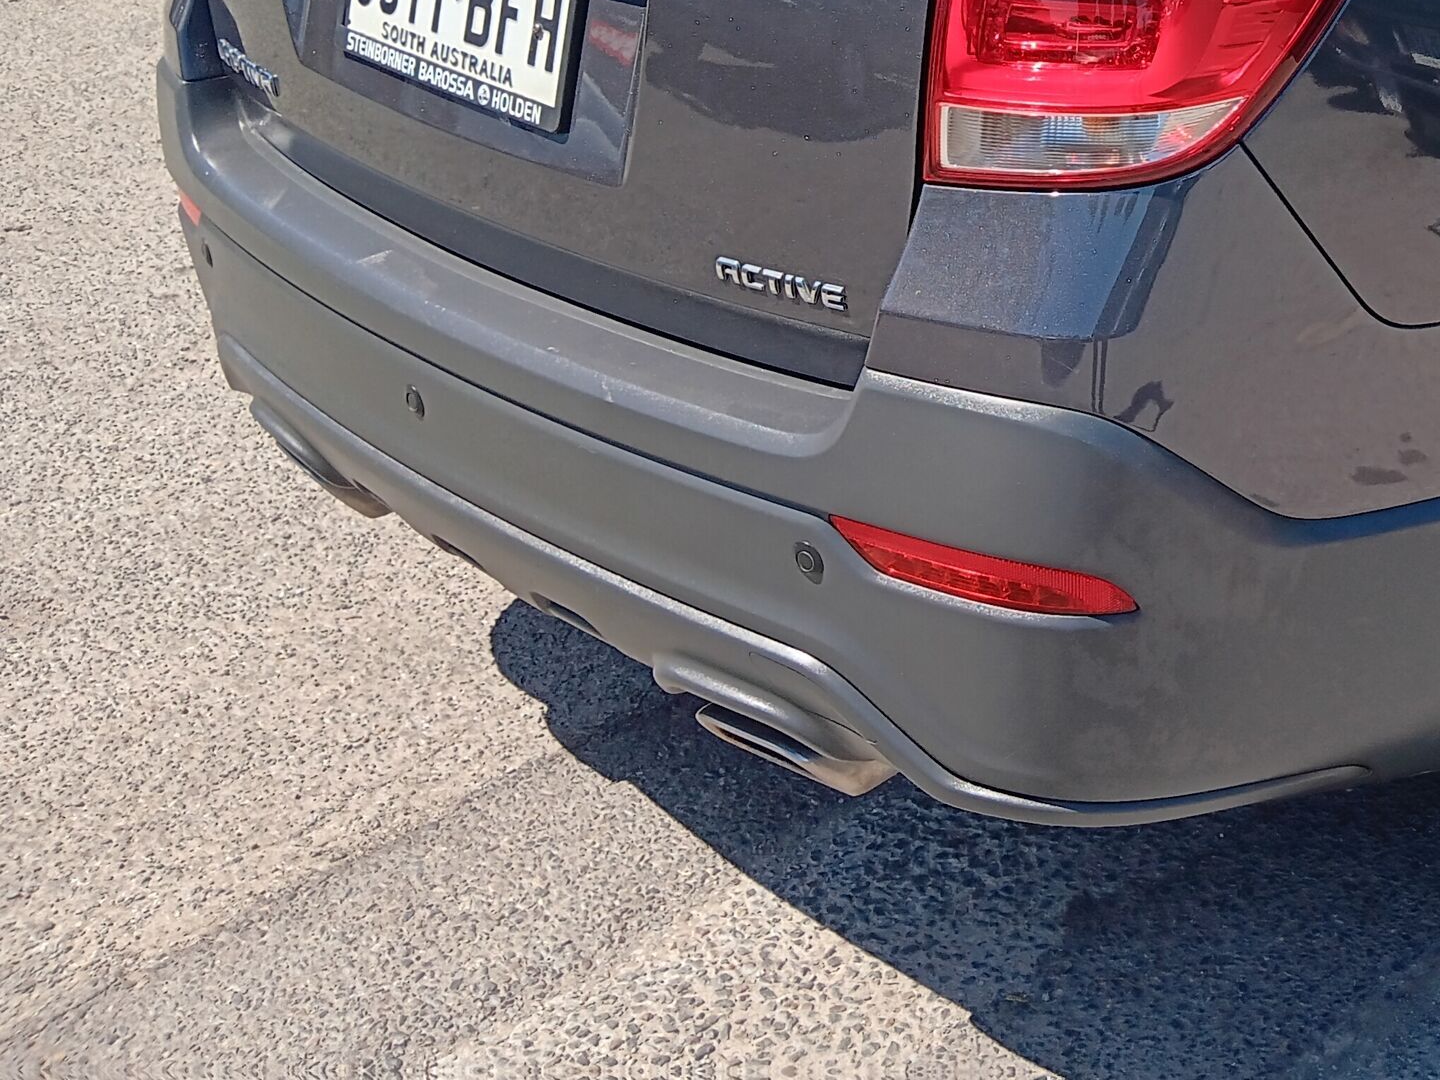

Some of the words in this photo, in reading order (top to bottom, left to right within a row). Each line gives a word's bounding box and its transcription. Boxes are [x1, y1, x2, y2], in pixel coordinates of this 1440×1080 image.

[346, 31, 415, 77] STEINBORNER
[417, 60, 475, 101] BAROSSA
[491, 89, 542, 124] HOLDEN
[381, 21, 425, 55] SOUTH
[430, 41, 513, 88] AUSTRALIA
[715, 255, 848, 312] ACTIVE
